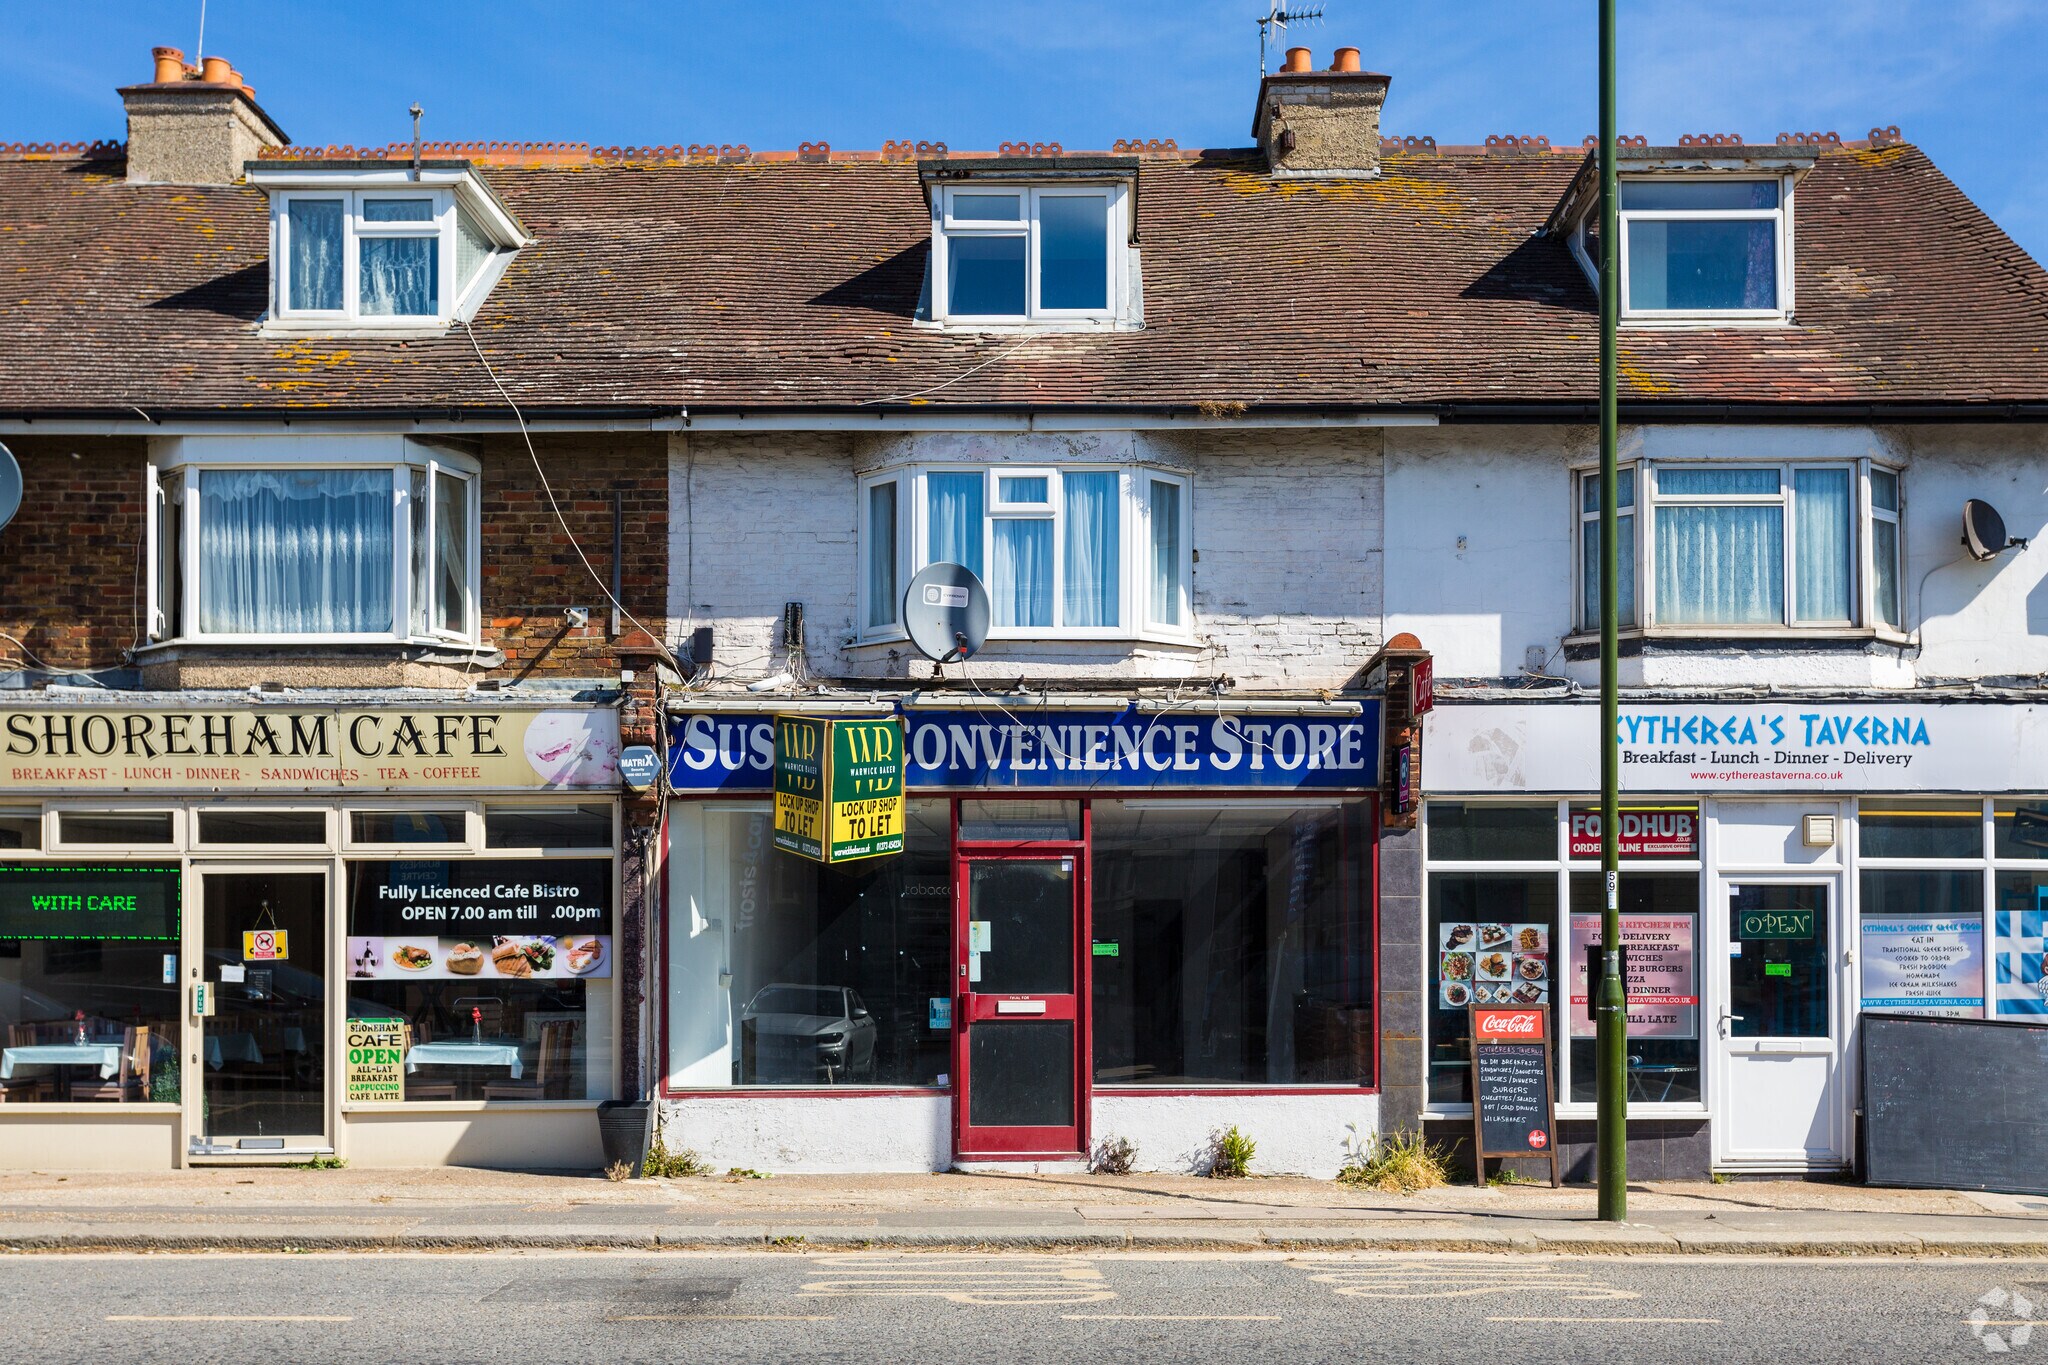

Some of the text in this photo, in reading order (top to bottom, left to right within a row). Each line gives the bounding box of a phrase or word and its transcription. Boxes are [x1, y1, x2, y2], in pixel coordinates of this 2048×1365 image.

[6, 714, 507, 761] SHOREHAM CAFE
[1799, 713, 1931, 747] TAVERNA
[684, 714, 774, 771] SUS
[1210, 715, 1365, 771] STORE
[621, 755, 654, 767] MATRIX
[1622, 750, 1913, 767] Breakfast Lunch Dinner Delivery
[12, 766, 480, 781] BREAKFAST LUNCH DINNER SANDWICHES TEA COFFEE
[784, 762, 804, 773] WARWICK
[850, 766, 896, 776] WARWICK BAKER
[1690, 770, 1843, 781] www.cythereastaverna.co.uk
[780, 794, 819, 815] LOCK UP SHOP
[841, 797, 897, 817] LOCK UP SHOP
[784, 810, 814, 838] TO LET
[849, 814, 891, 839] TO LET
[1572, 814, 1693, 838] FODHUB
[379, 884, 580, 902] Fully Licenced Cafe Bistro
[32, 895, 137, 911] WITH CARE
[402, 906, 447, 920] OPEN
[451, 906, 485, 920] 7.00
[488, 909, 513, 920] am
[516, 905, 538, 920] till
[1745, 913, 1810, 933] OPEN
[1482, 1014, 1537, 1033] Coca-Cola
[1647, 1015, 1678, 1023] LATE
[350, 1024, 398, 1032] SHOREHAM
[348, 1034, 402, 1047] CAFE
[349, 1049, 401, 1064] OPEN
[349, 1083, 400, 1091] CAPPUCCINO
[1492, 1086, 1529, 1094] BURGERS
